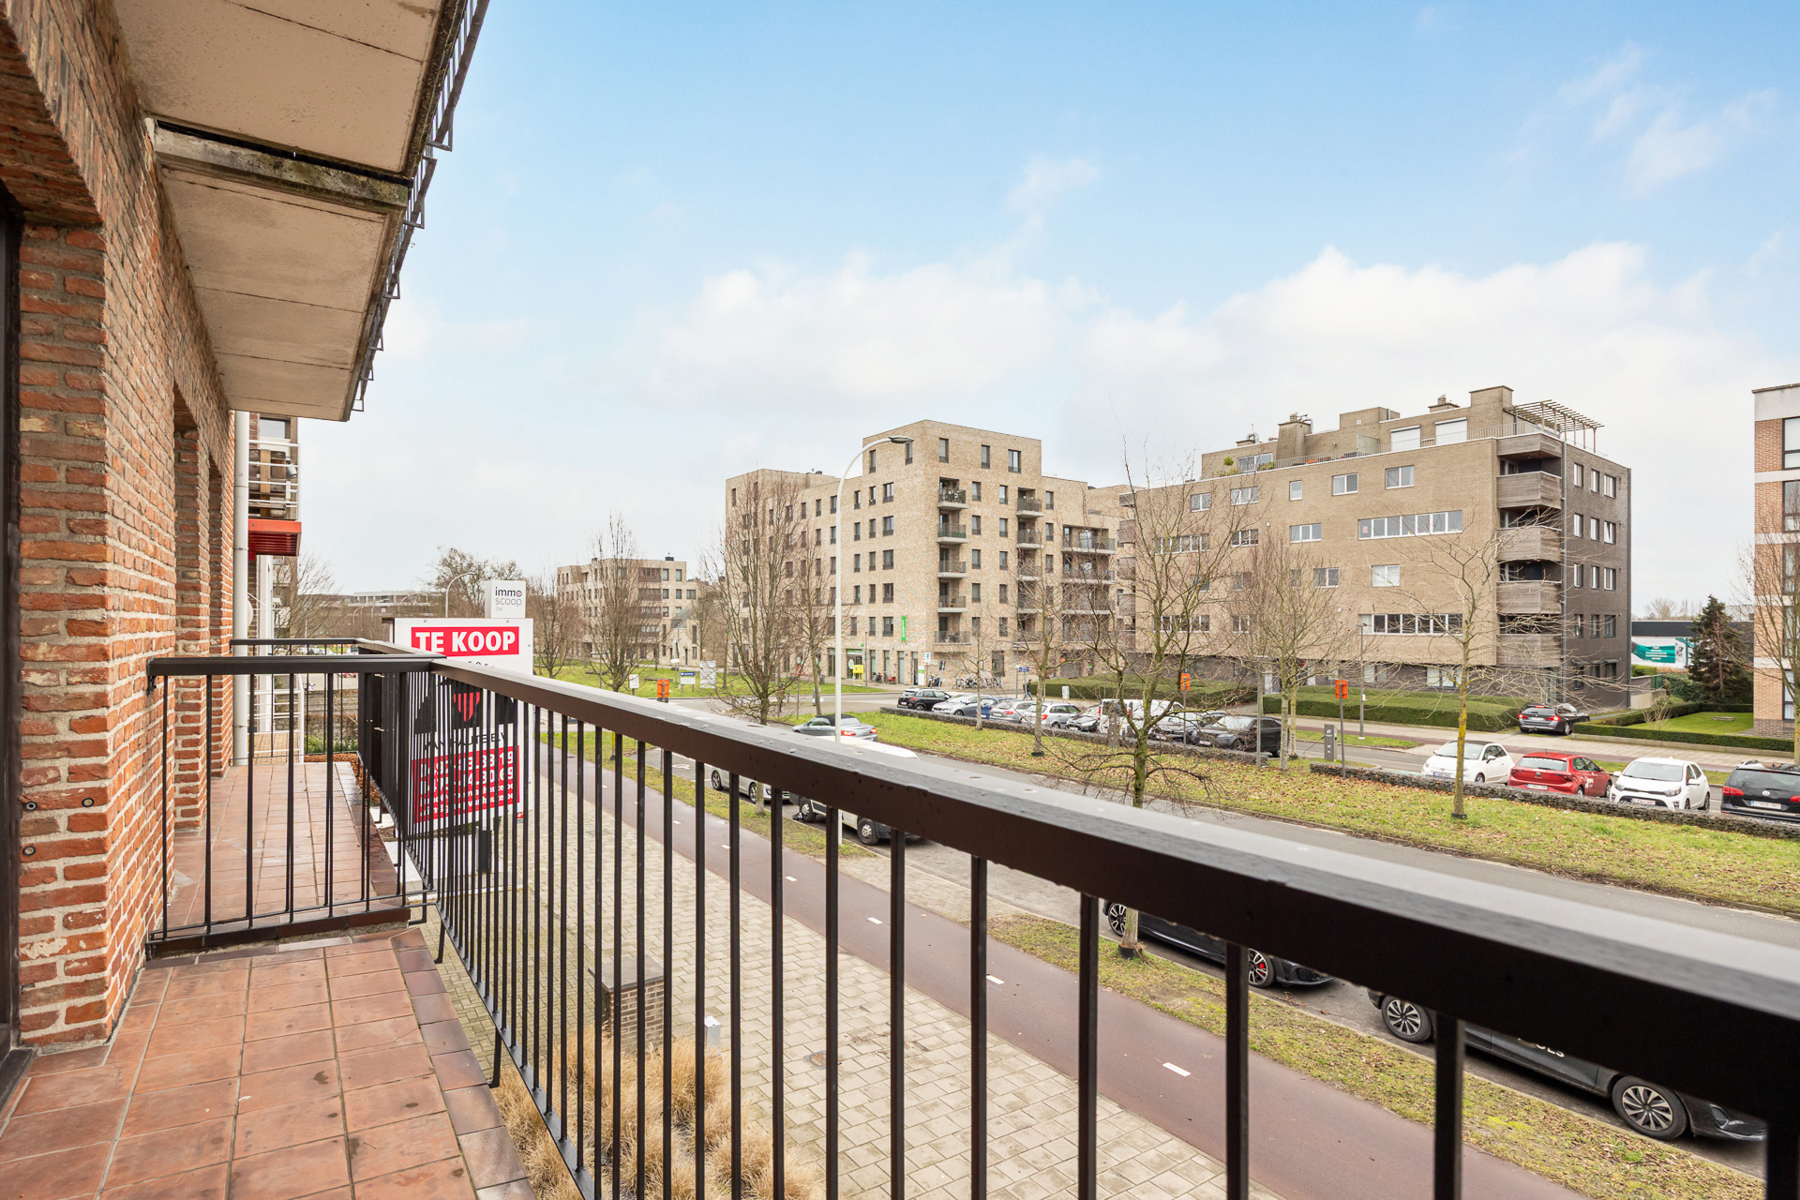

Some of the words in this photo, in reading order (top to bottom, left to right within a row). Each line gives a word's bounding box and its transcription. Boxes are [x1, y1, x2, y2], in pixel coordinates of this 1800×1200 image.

[495, 586, 523, 597] immo
[495, 597, 523, 607] scoop
[415, 631, 444, 652] TE
[452, 631, 515, 652] KOOP
